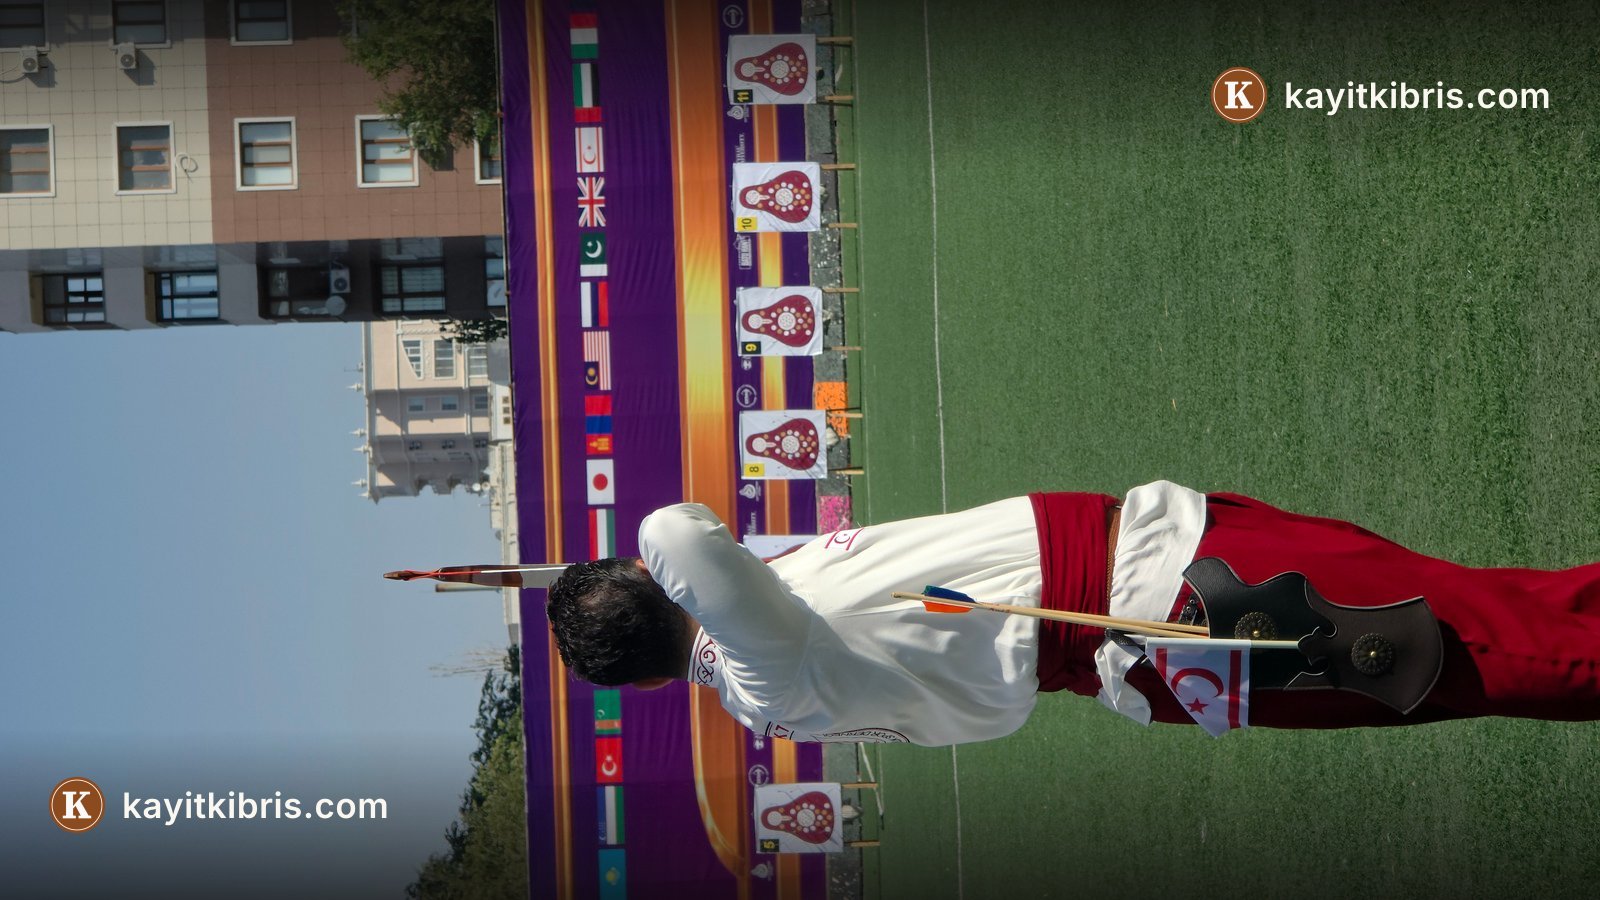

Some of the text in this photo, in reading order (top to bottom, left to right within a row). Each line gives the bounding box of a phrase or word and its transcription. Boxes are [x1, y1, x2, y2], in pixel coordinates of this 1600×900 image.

[737, 92, 749, 103] 11
[741, 218, 752, 230] 10
[745, 343, 757, 352] 9
[763, 841, 775, 850] 5
